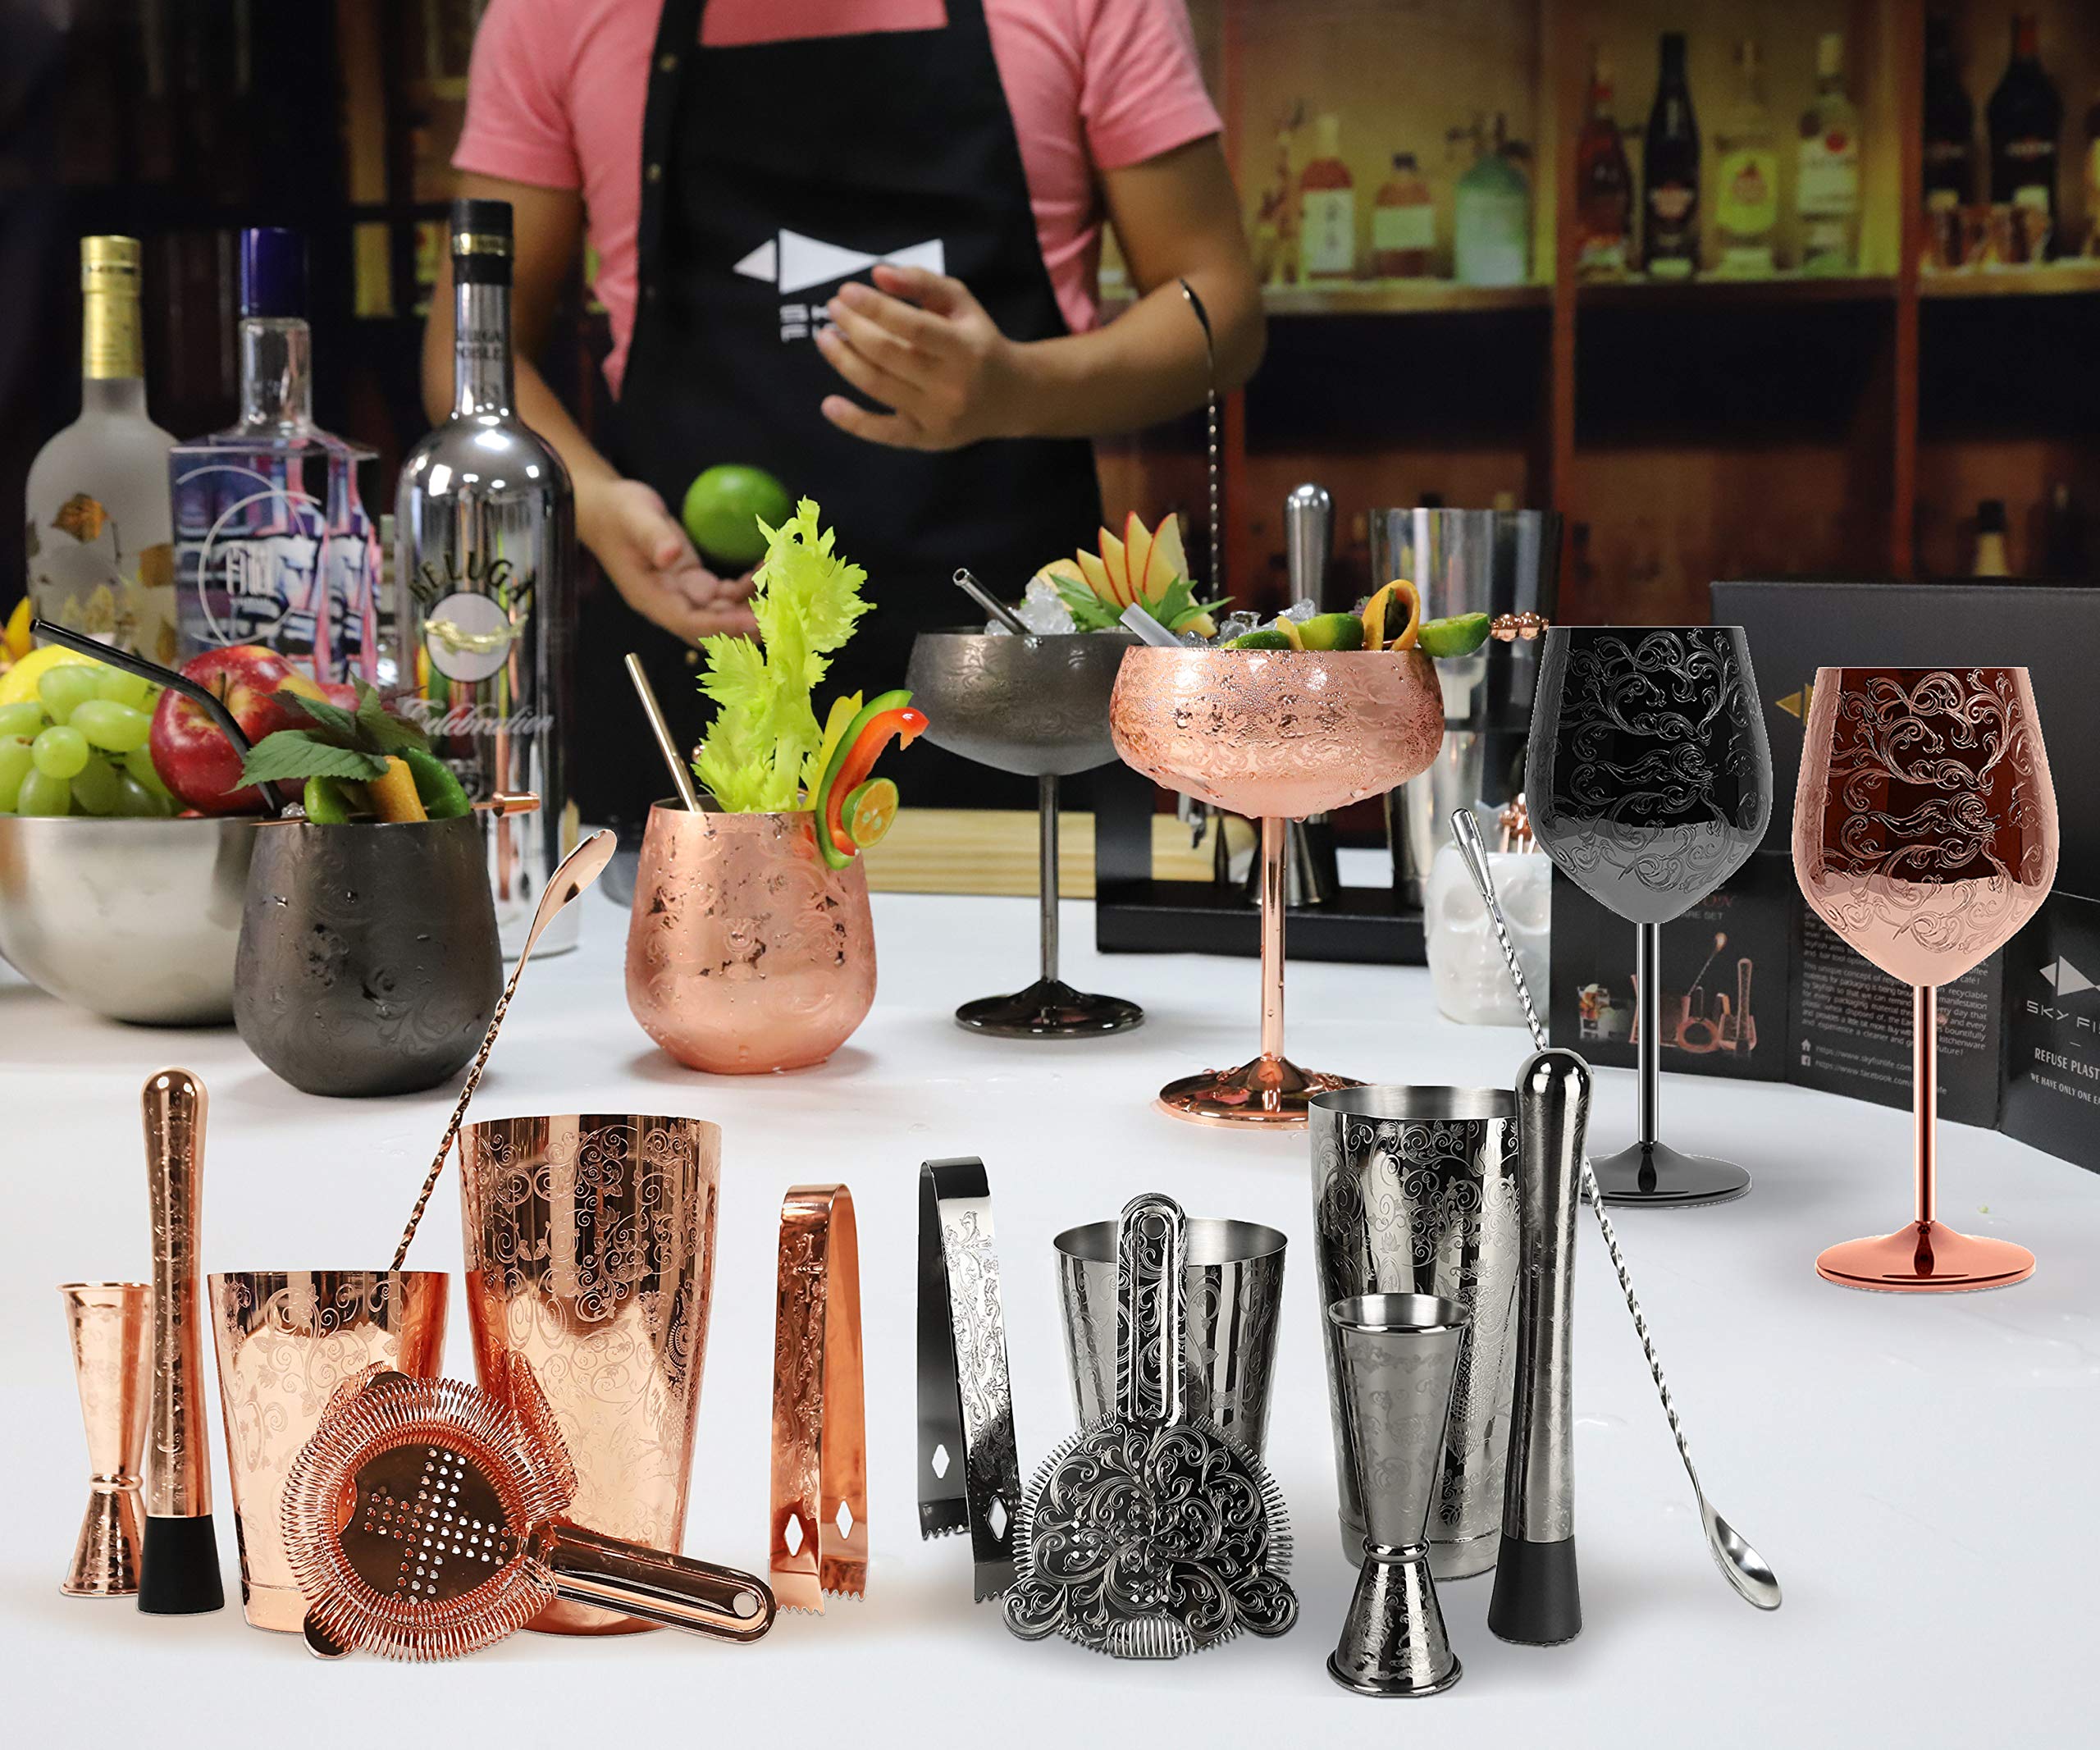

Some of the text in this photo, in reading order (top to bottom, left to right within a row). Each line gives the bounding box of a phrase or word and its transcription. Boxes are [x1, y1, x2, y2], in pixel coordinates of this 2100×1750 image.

[780, 304, 828, 322] SK
[409, 551, 536, 604] BELUGA
[401, 698, 555, 737] Celebration
[1948, 988, 1988, 1001] recyclable
[1939, 997, 1988, 1011] manifestation
[2026, 1000, 2069, 1021] SKY
[1954, 1008, 1969, 1019] day
[1970, 1011, 1987, 1021] that
[1950, 1018, 1964, 1026] and
[1966, 1021, 1987, 1032] every
[1938, 1035, 1987, 1050] kitchenware
[1945, 1026, 1987, 1042] bountifully
[2034, 1047, 2068, 1070] REFUSE
[2030, 1072, 2040, 1084] WE
[2041, 1076, 2057, 1090] HAVE
[2058, 1082, 2076, 1097] ONLY
[2077, 1090, 2092, 1103] ONE
